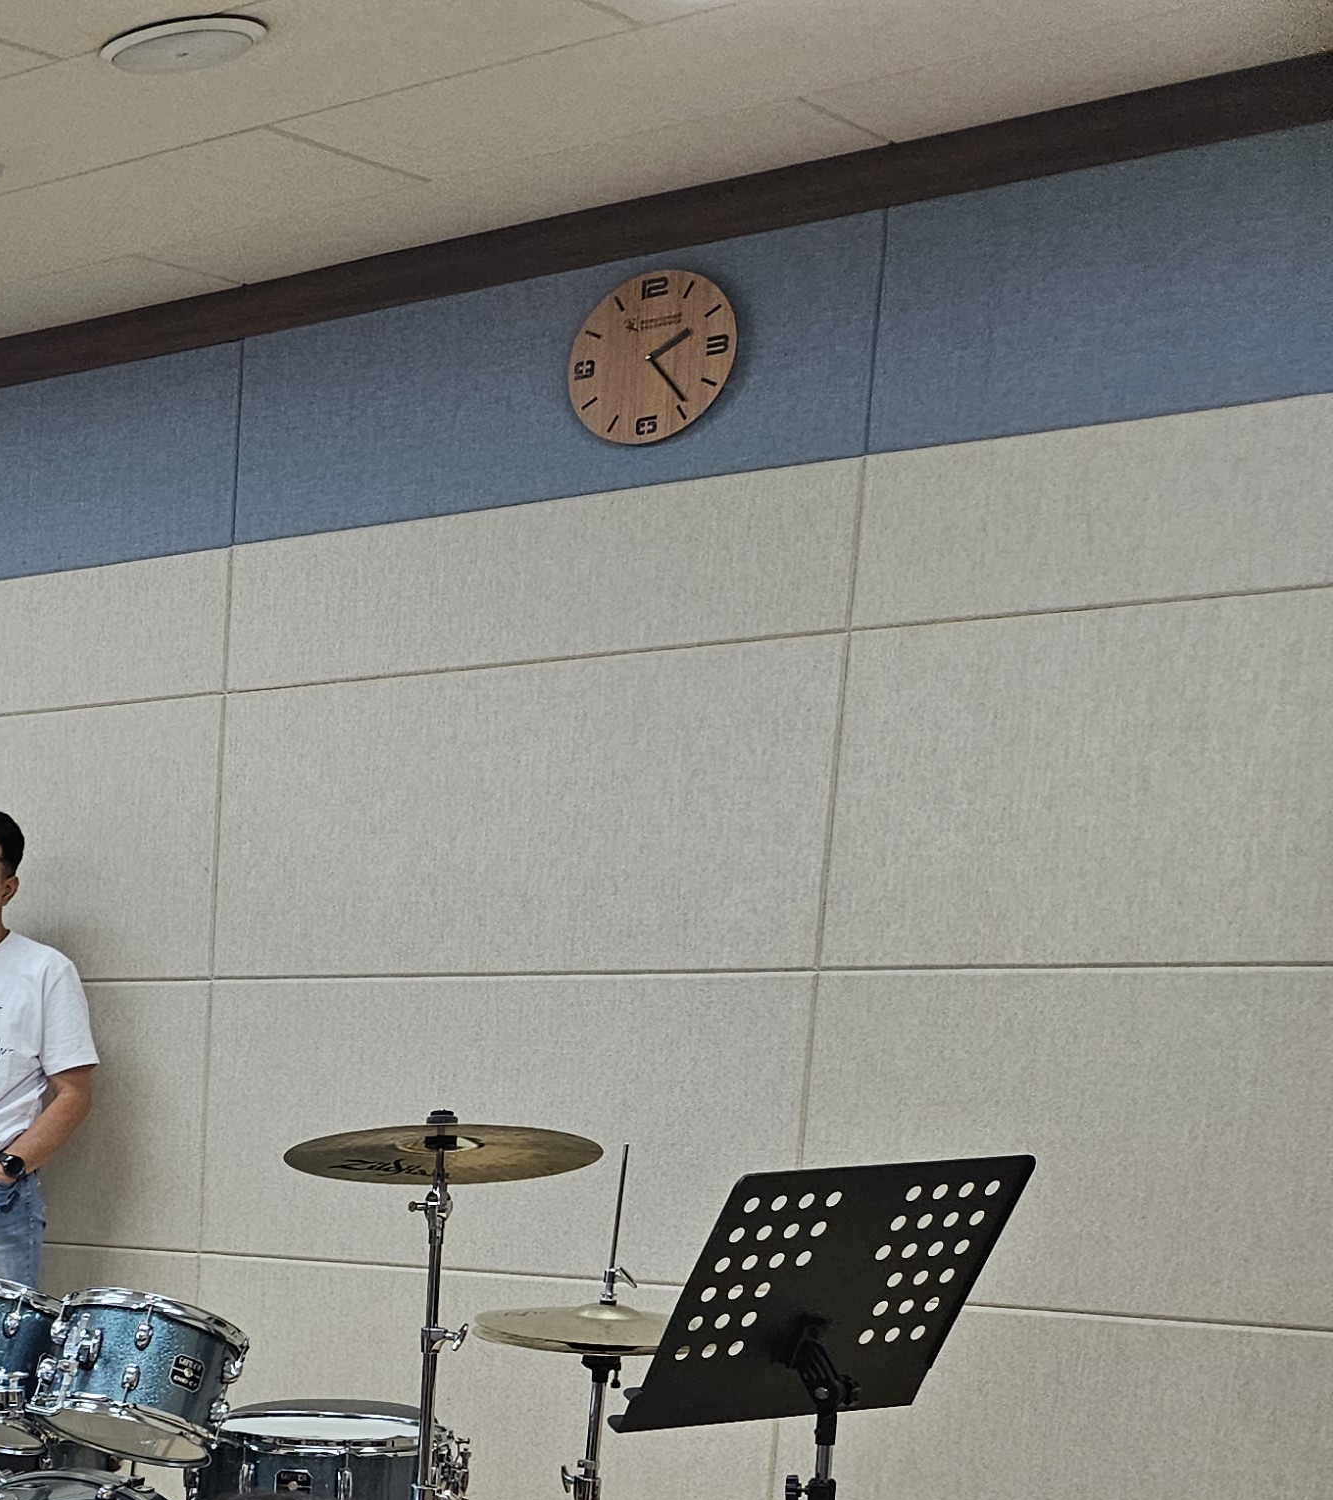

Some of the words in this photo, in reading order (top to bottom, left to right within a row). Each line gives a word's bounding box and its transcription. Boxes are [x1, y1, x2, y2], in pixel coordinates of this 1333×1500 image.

[641, 276, 669, 300] 12
[706, 334, 730, 356] 3
[574, 360, 596, 381] 9
[635, 415, 658, 436] 6
